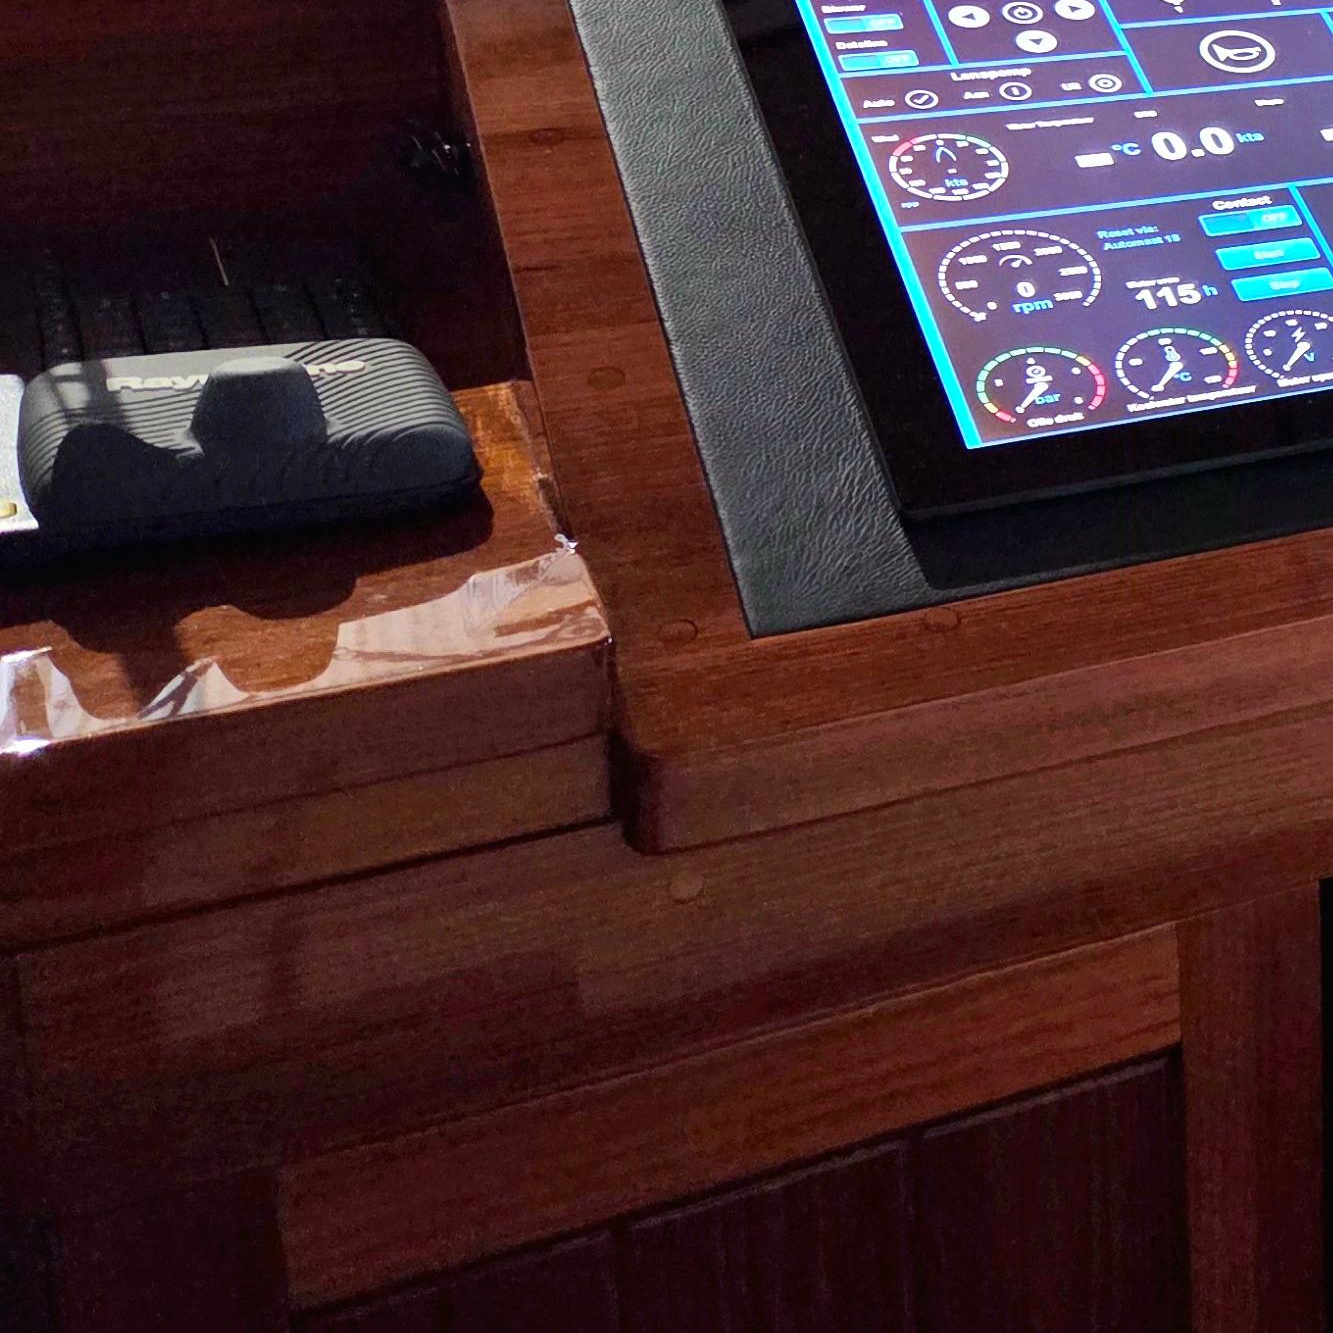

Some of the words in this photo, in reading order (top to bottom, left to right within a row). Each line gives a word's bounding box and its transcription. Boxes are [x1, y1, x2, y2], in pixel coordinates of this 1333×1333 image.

[1112, 143, 1140, 154] °C
[1152, 127, 1234, 160] 0.0
[1238, 133, 1263, 142] kts
[1212, 195, 1272, 210] Contact
[1098, 229, 1134, 238] Reset
[1017, 282, 1035, 297] 0
[1135, 283, 1201, 309] 115
[1203, 286, 1216, 296] h
[1014, 300, 1052, 313] rpm
[1305, 352, 1315, 362] V
[1036, 394, 1060, 404] bar
